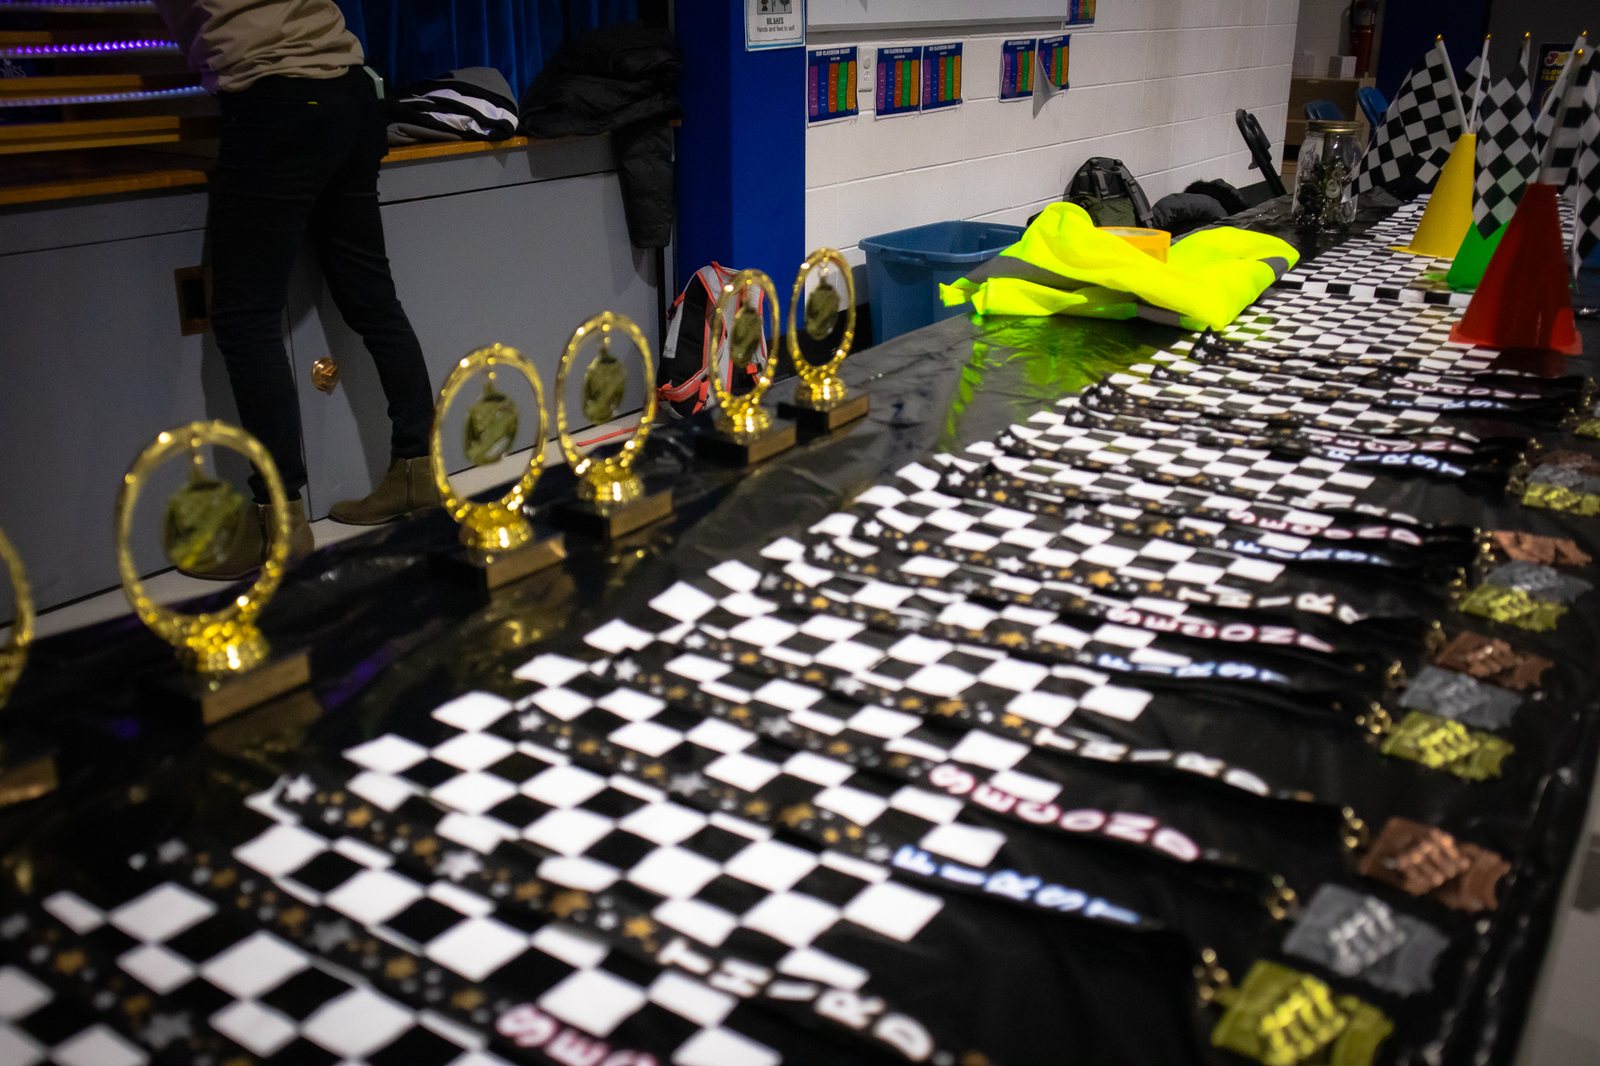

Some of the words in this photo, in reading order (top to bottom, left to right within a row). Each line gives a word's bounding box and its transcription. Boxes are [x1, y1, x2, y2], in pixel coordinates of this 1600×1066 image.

[773, 16, 784, 24] SAFE
[1392, 375, 1542, 399] SECON
[1327, 448, 1467, 477] FIRST
[1227, 509, 1423, 547] SECOND
[1033, 726, 1271, 797] THIRD
[928, 763, 1202, 863] SECOND
[891, 843, 1143, 926] FIRST
[655, 938, 935, 1063] THIRD
